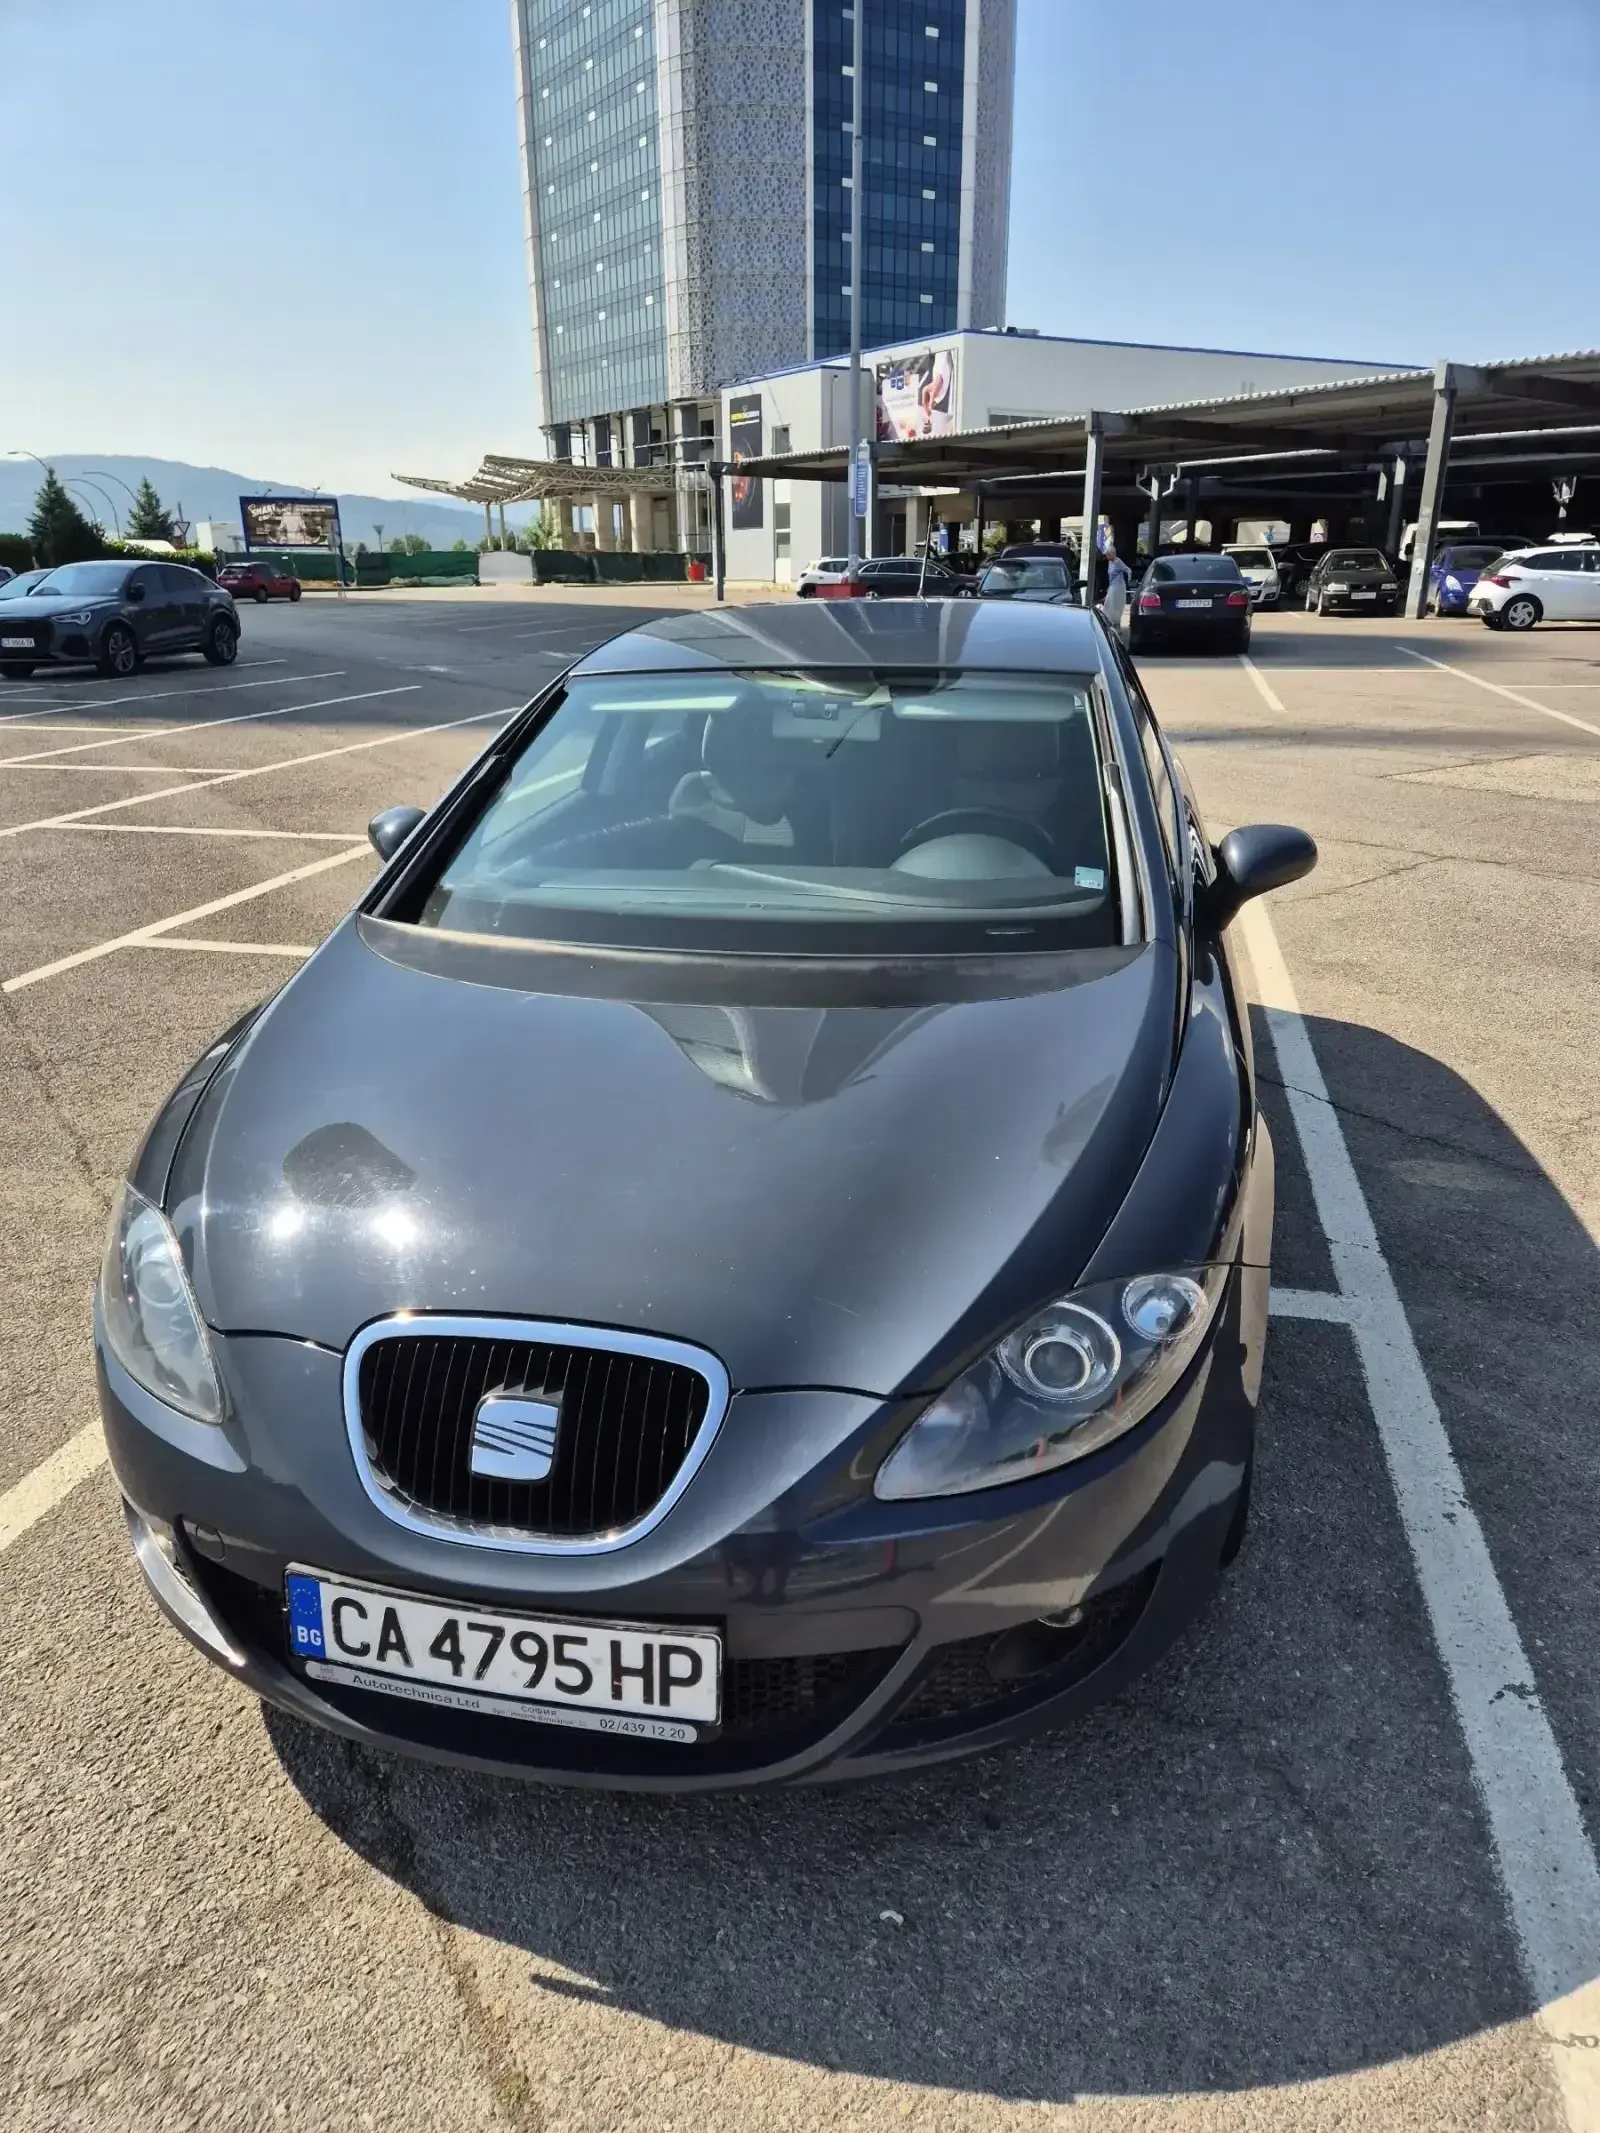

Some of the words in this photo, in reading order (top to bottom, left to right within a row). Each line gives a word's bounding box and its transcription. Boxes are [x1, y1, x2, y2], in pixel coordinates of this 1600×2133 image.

[297, 1625, 322, 1646] BG
[331, 1596, 414, 1668] CA
[428, 1619, 593, 1696] 4795
[610, 1640, 702, 1707] HP
[352, 1675, 453, 1704] Autotechnica
[457, 1697, 480, 1709] Ltd
[521, 1705, 557, 1716] СОФИЯ
[600, 1718, 645, 1734] 02/439
[651, 1724, 665, 1737] 12
[670, 1727, 686, 1740] 20
